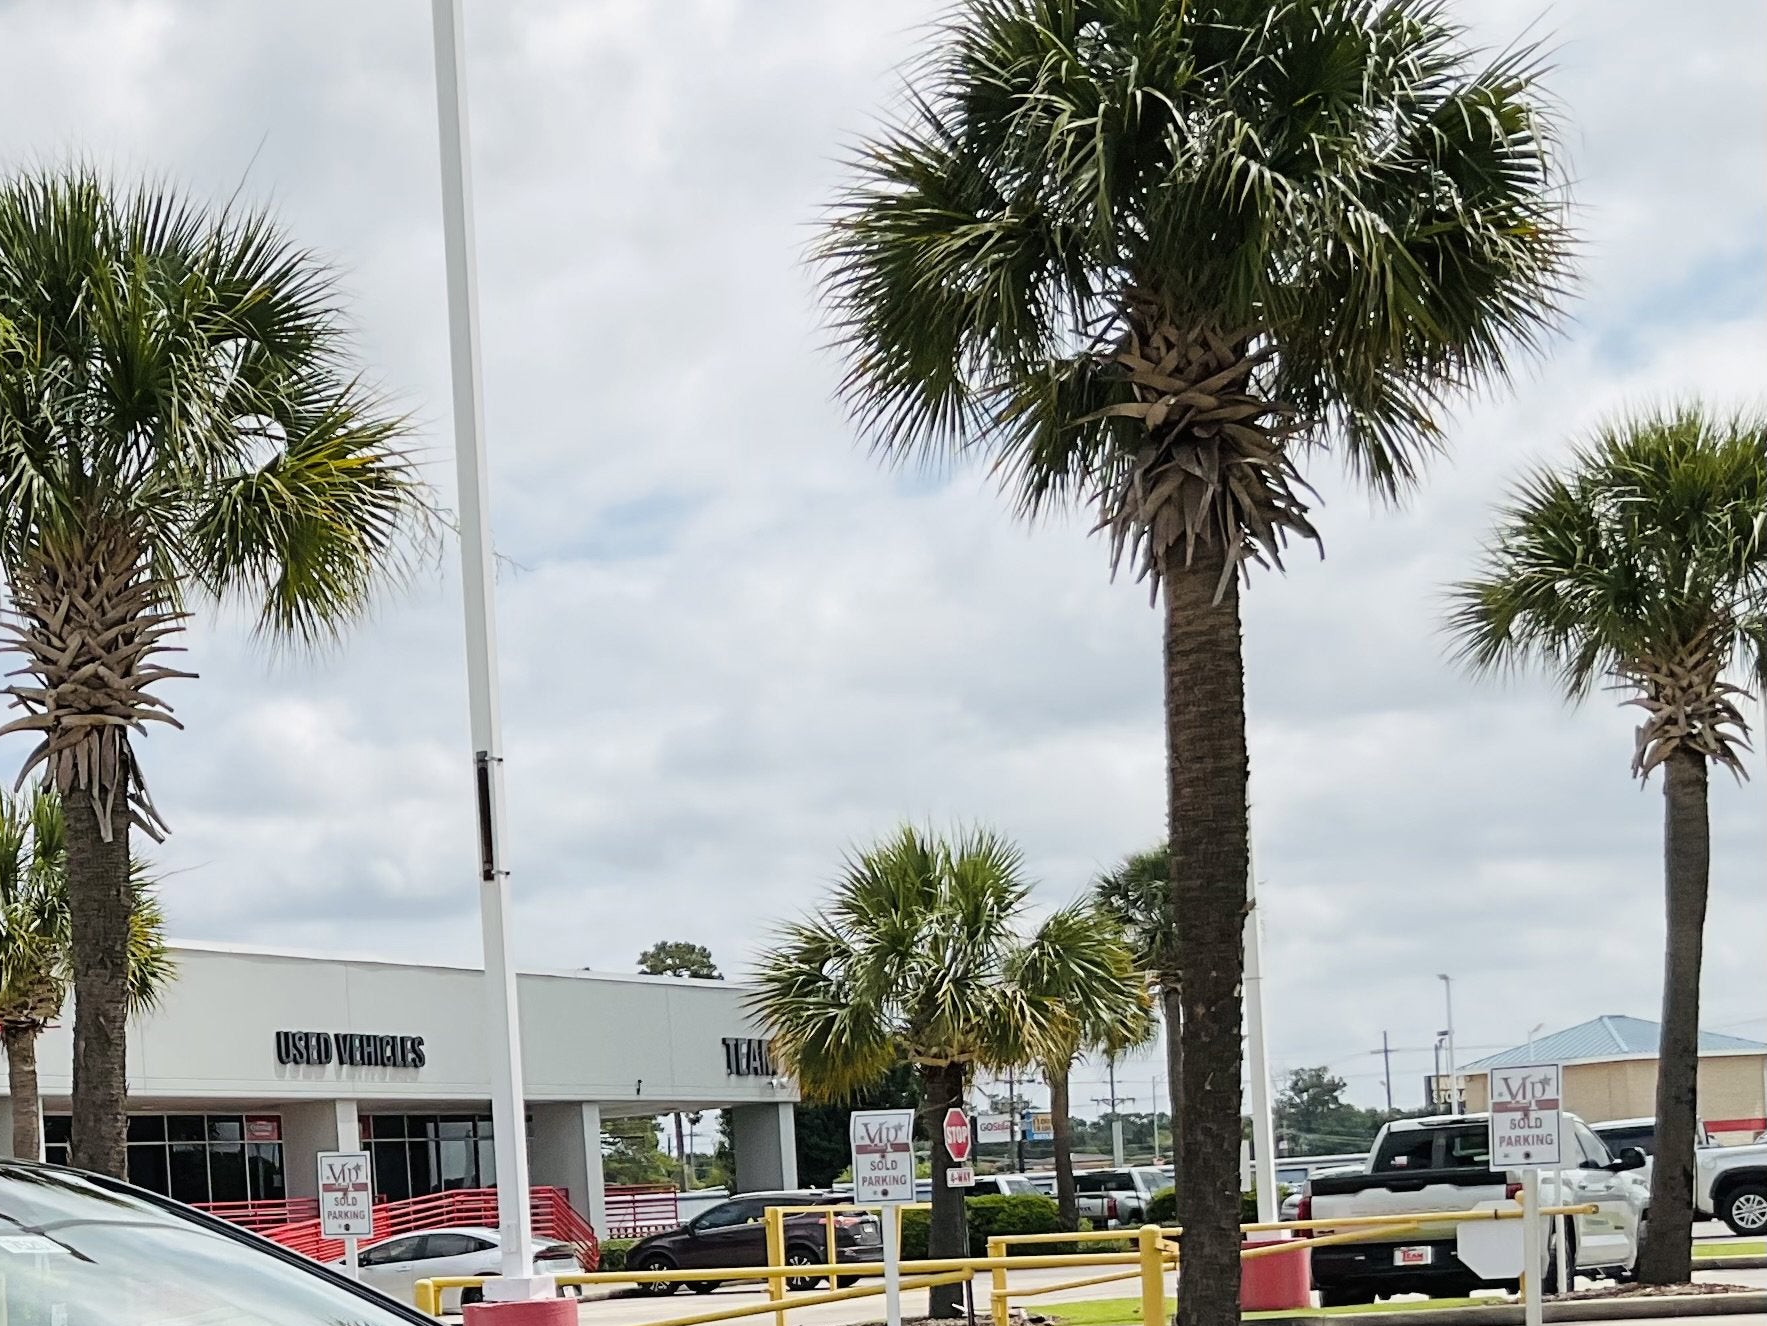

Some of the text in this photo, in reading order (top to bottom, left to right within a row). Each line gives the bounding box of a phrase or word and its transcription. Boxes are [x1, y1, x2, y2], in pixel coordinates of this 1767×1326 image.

[275, 1030, 426, 1068] USED VEHICLES
[1509, 1117, 1543, 1130] SOLD
[946, 1125, 968, 1144] STOP
[1498, 1133, 1554, 1148] PARKING
[870, 1159, 898, 1172] SOLD
[861, 1174, 907, 1187] PARKING
[333, 1196, 358, 1207] SOLD
[327, 1210, 366, 1221] PARKING
